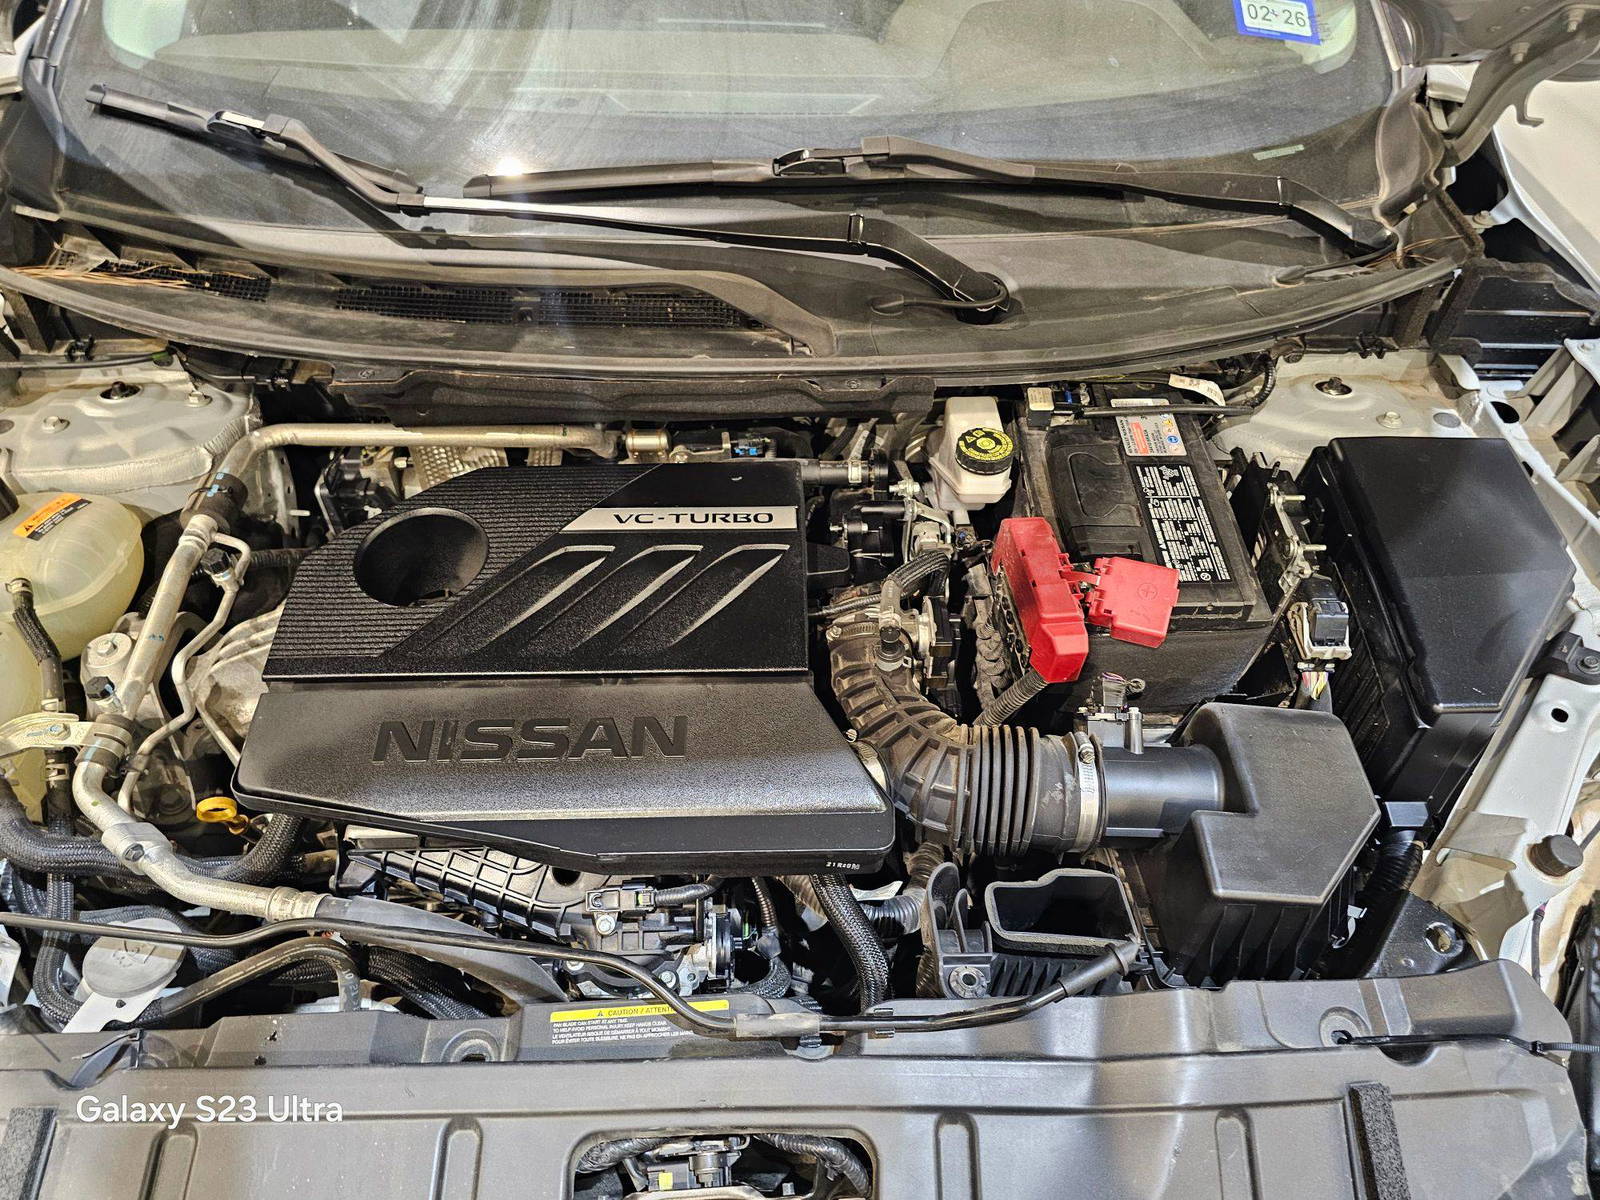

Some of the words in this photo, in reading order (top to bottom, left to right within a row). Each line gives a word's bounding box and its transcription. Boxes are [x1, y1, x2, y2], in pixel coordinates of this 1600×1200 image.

[1247, 4, 1272, 22] 02
[1282, 9, 1306, 27] 26
[613, 513, 774, 524] VC-TURBO
[372, 716, 689, 764] NISSAN
